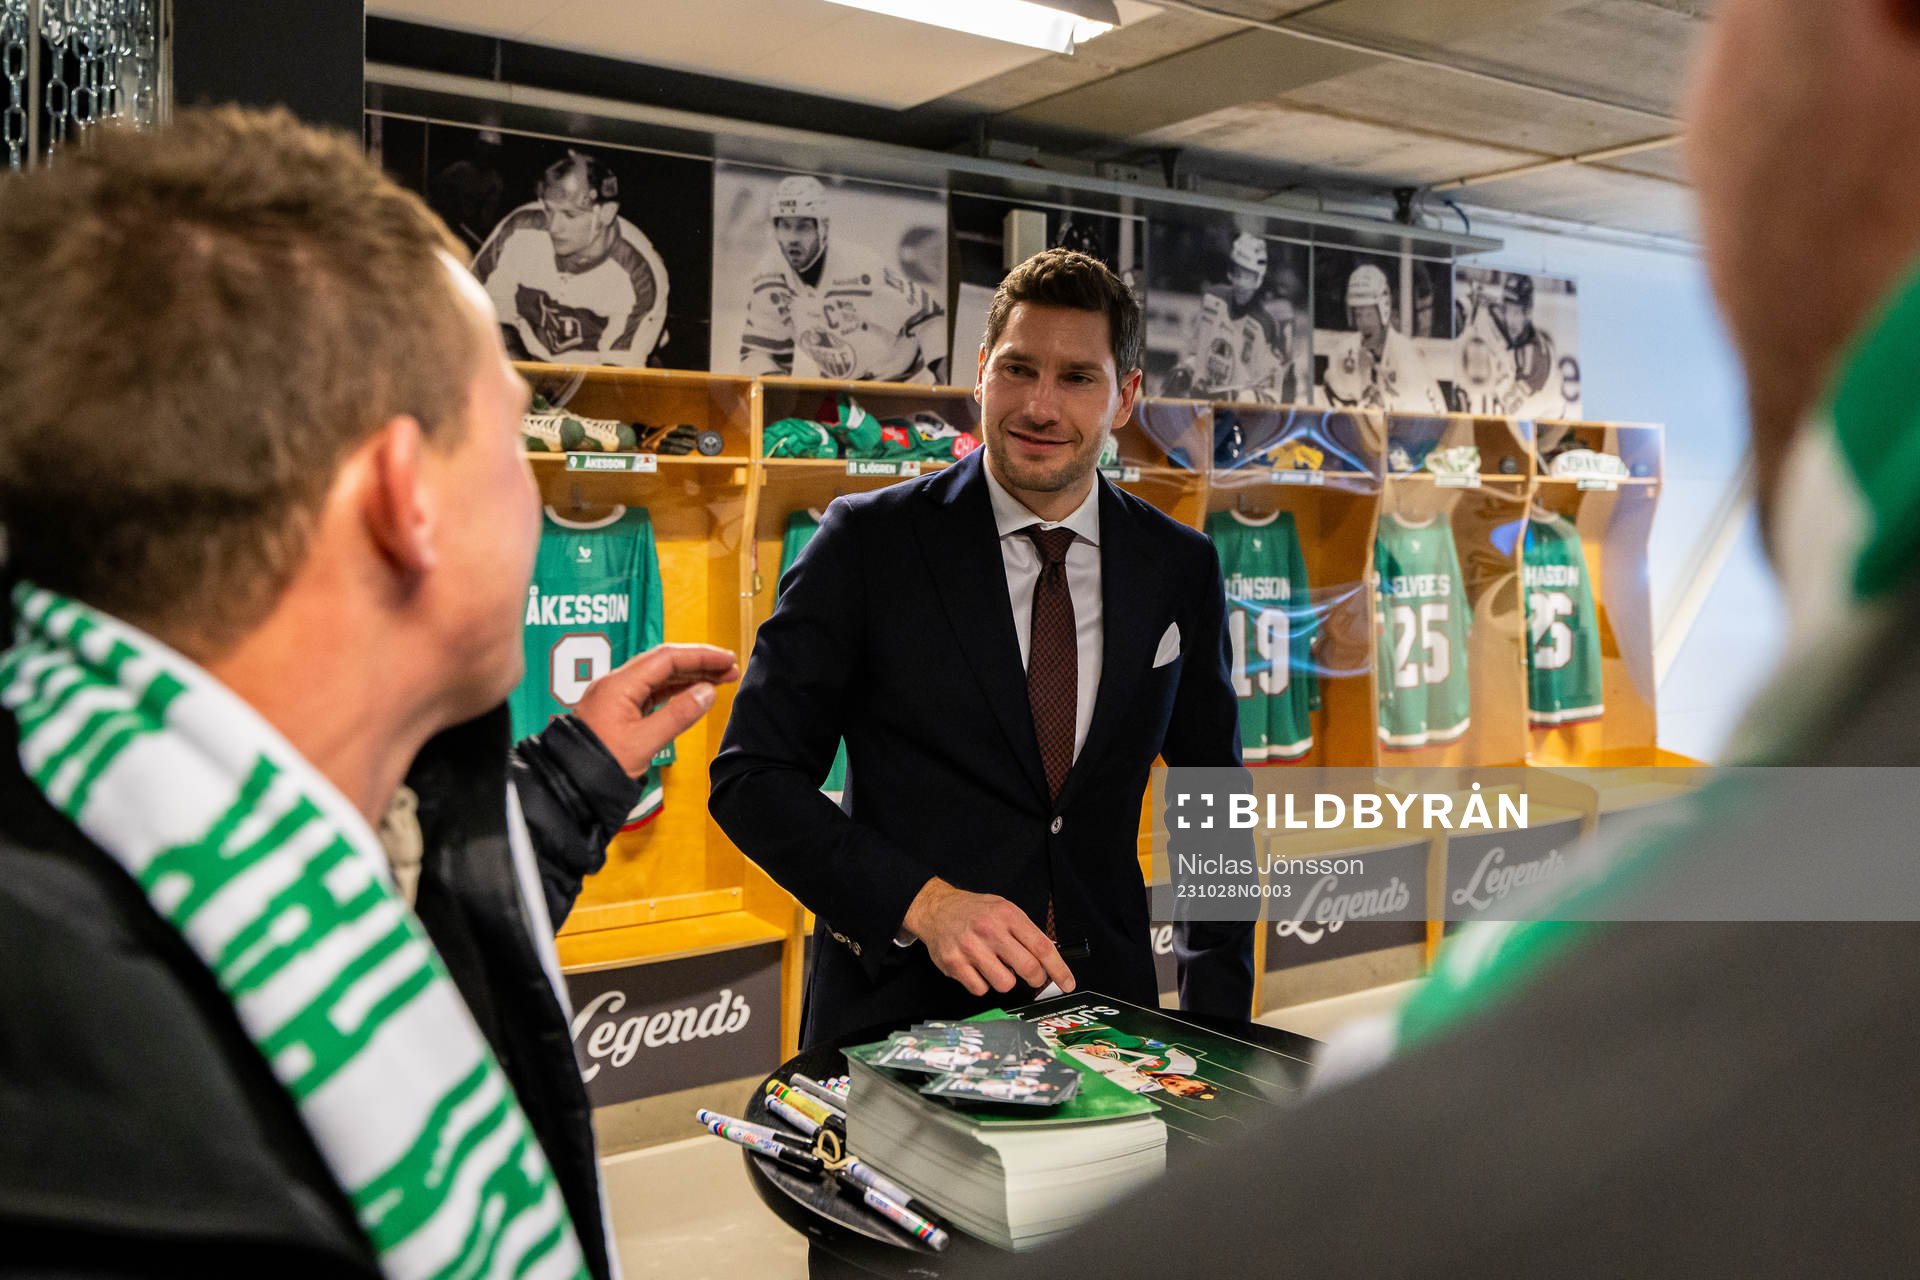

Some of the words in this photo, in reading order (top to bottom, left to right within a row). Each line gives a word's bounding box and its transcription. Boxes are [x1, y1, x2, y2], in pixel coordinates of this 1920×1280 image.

[583, 455, 627, 470] ÅKESSON
[525, 584, 629, 625] ÅKESSON
[1228, 606, 1291, 697] 19
[1393, 603, 1451, 688] 25
[1275, 874, 1411, 946] Legends
[571, 988, 752, 1084] Legends
